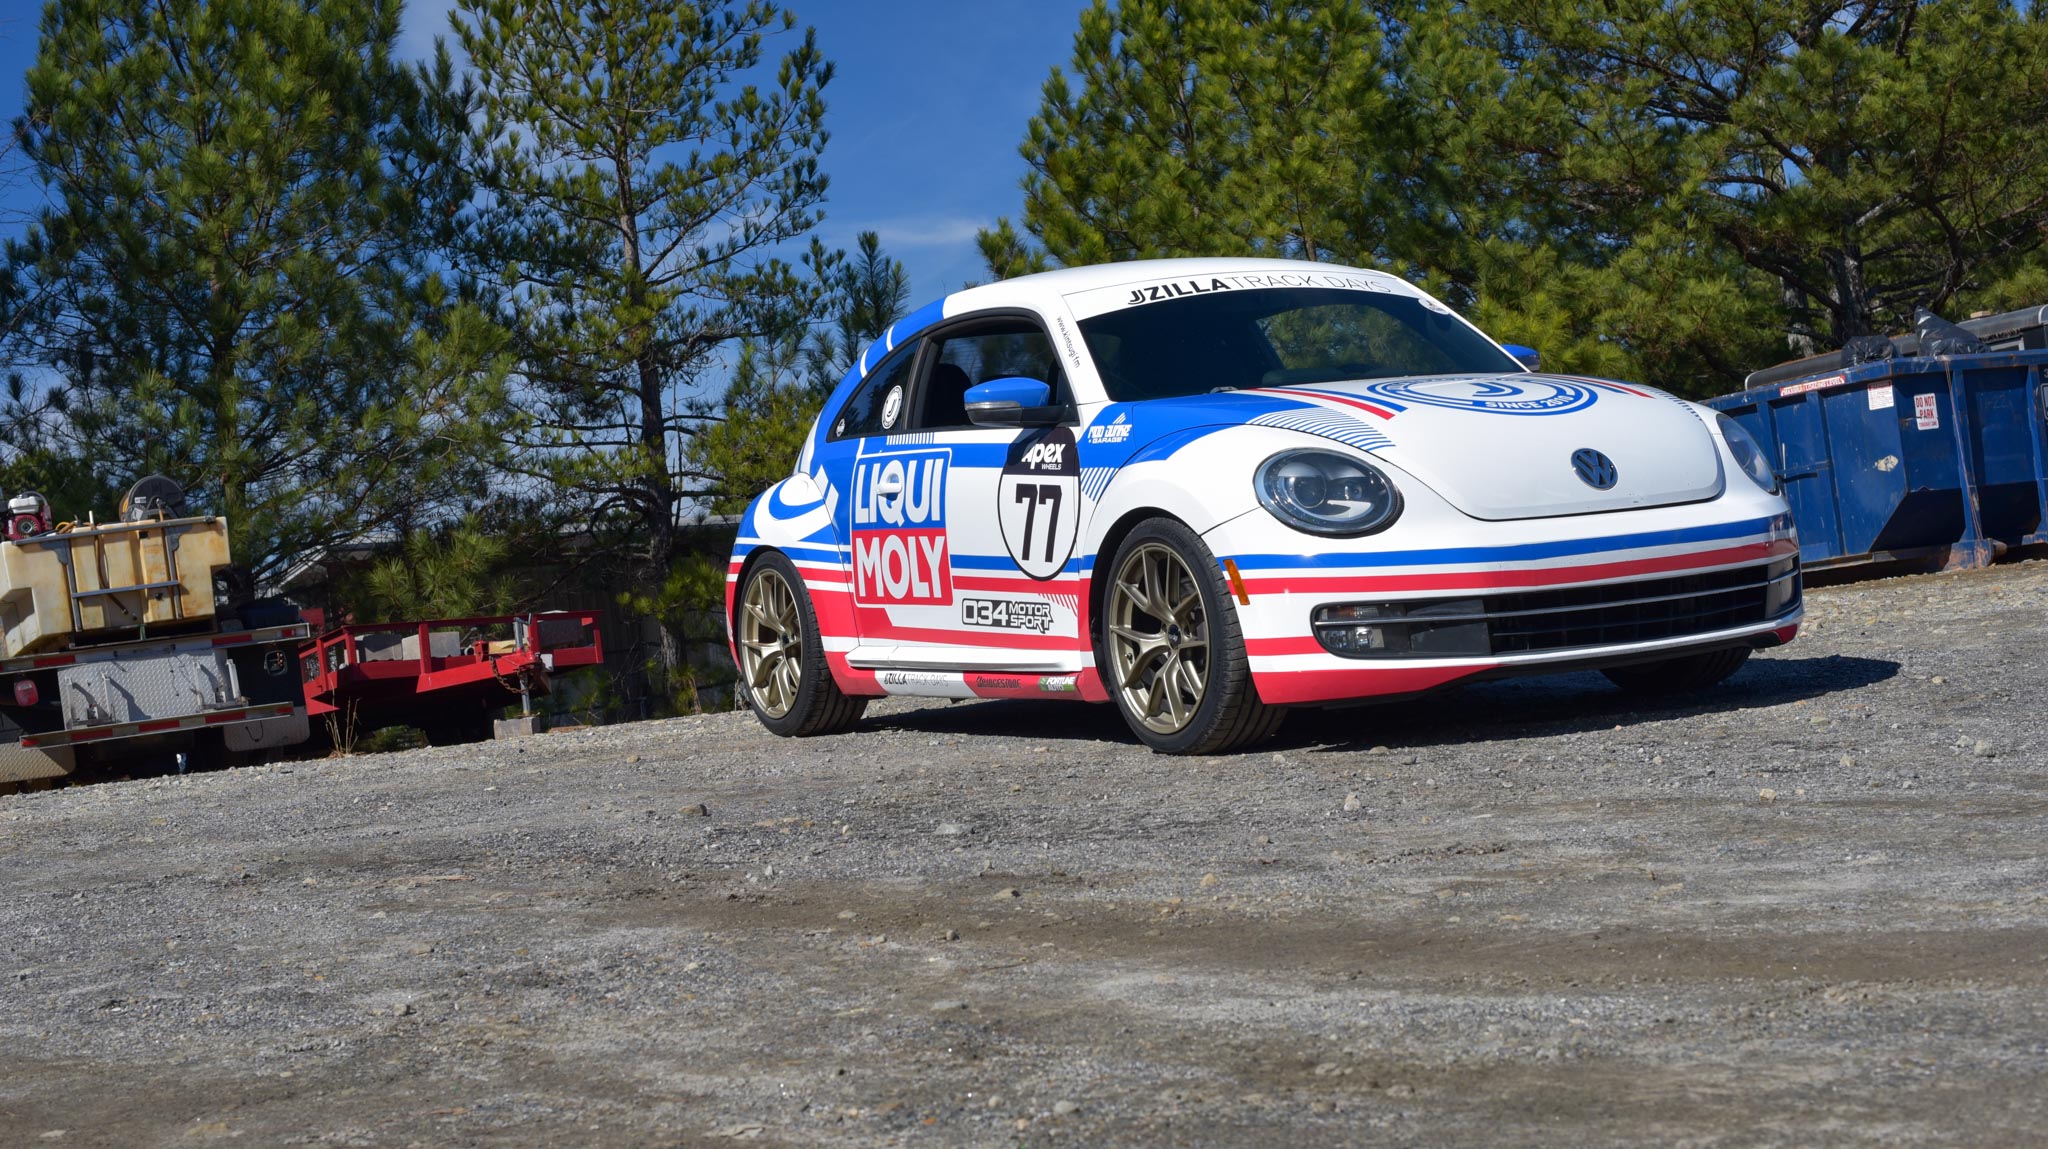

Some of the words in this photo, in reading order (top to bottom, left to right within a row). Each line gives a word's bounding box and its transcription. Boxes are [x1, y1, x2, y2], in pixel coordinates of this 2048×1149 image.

[1323, 276, 1392, 292] DAYS
[1485, 401, 1543, 409] SINCE
[1915, 397, 1924, 408] DO
[1924, 395, 1935, 407] NOT
[1919, 408, 1935, 420] PARK
[1041, 463, 1062, 471] WHEELS
[855, 458, 944, 527] LIQUI
[1015, 483, 1062, 563] 77
[855, 534, 945, 600] MOLY
[962, 599, 1008, 626] 034
[1008, 602, 1052, 619] MOTOR
[1010, 614, 1051, 632] SPORT
